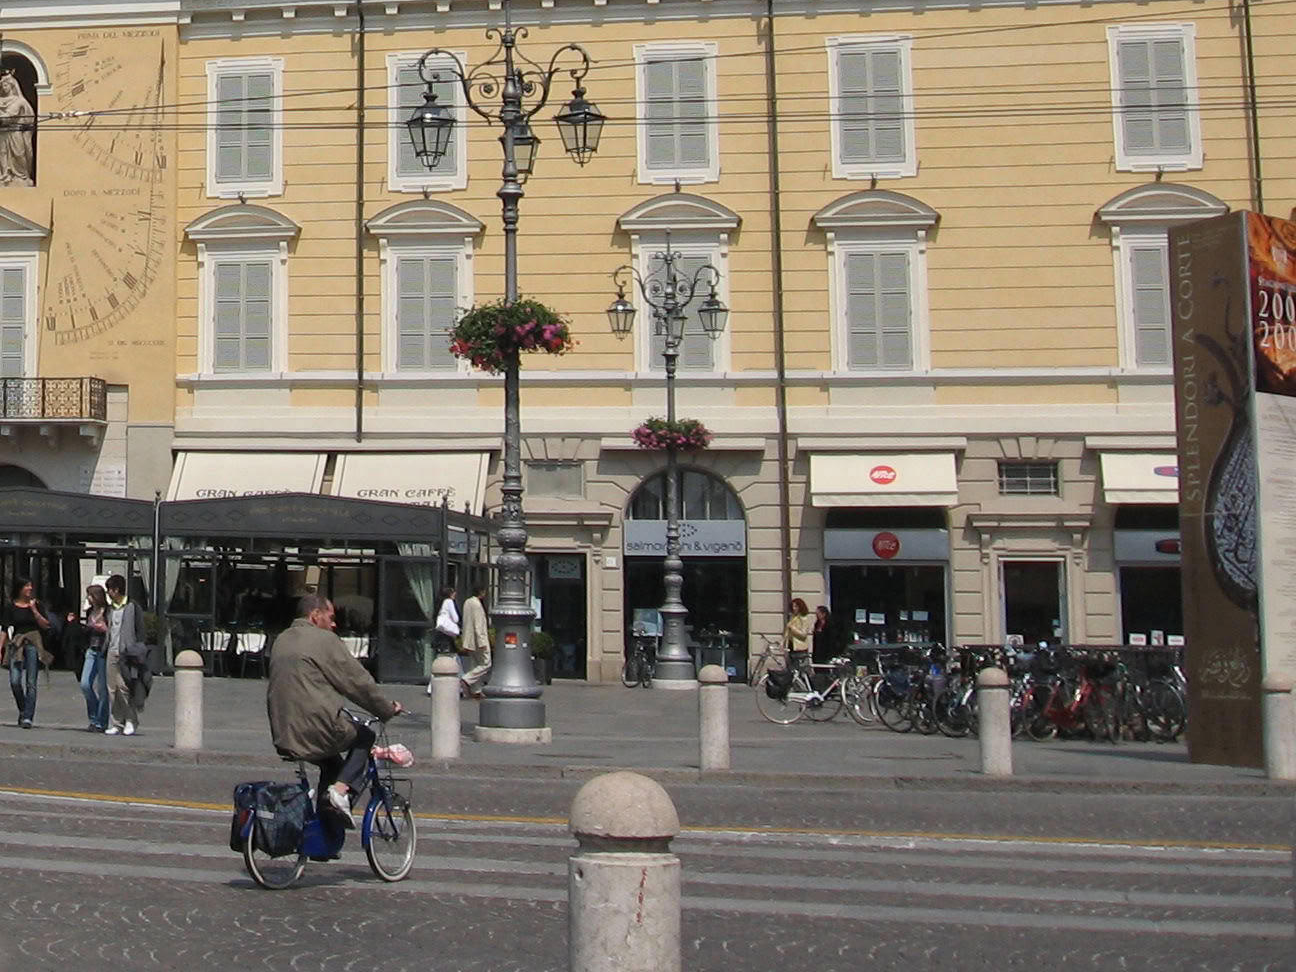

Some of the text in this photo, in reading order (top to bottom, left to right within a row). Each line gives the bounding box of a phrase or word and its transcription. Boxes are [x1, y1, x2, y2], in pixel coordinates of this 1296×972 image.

[1177, 234, 1194, 320] CORTE
[1183, 355, 1202, 501] SPLENDORI
[196, 489, 237, 498] GRAN
[357, 487, 456, 498] GRAN CAFFÈ
